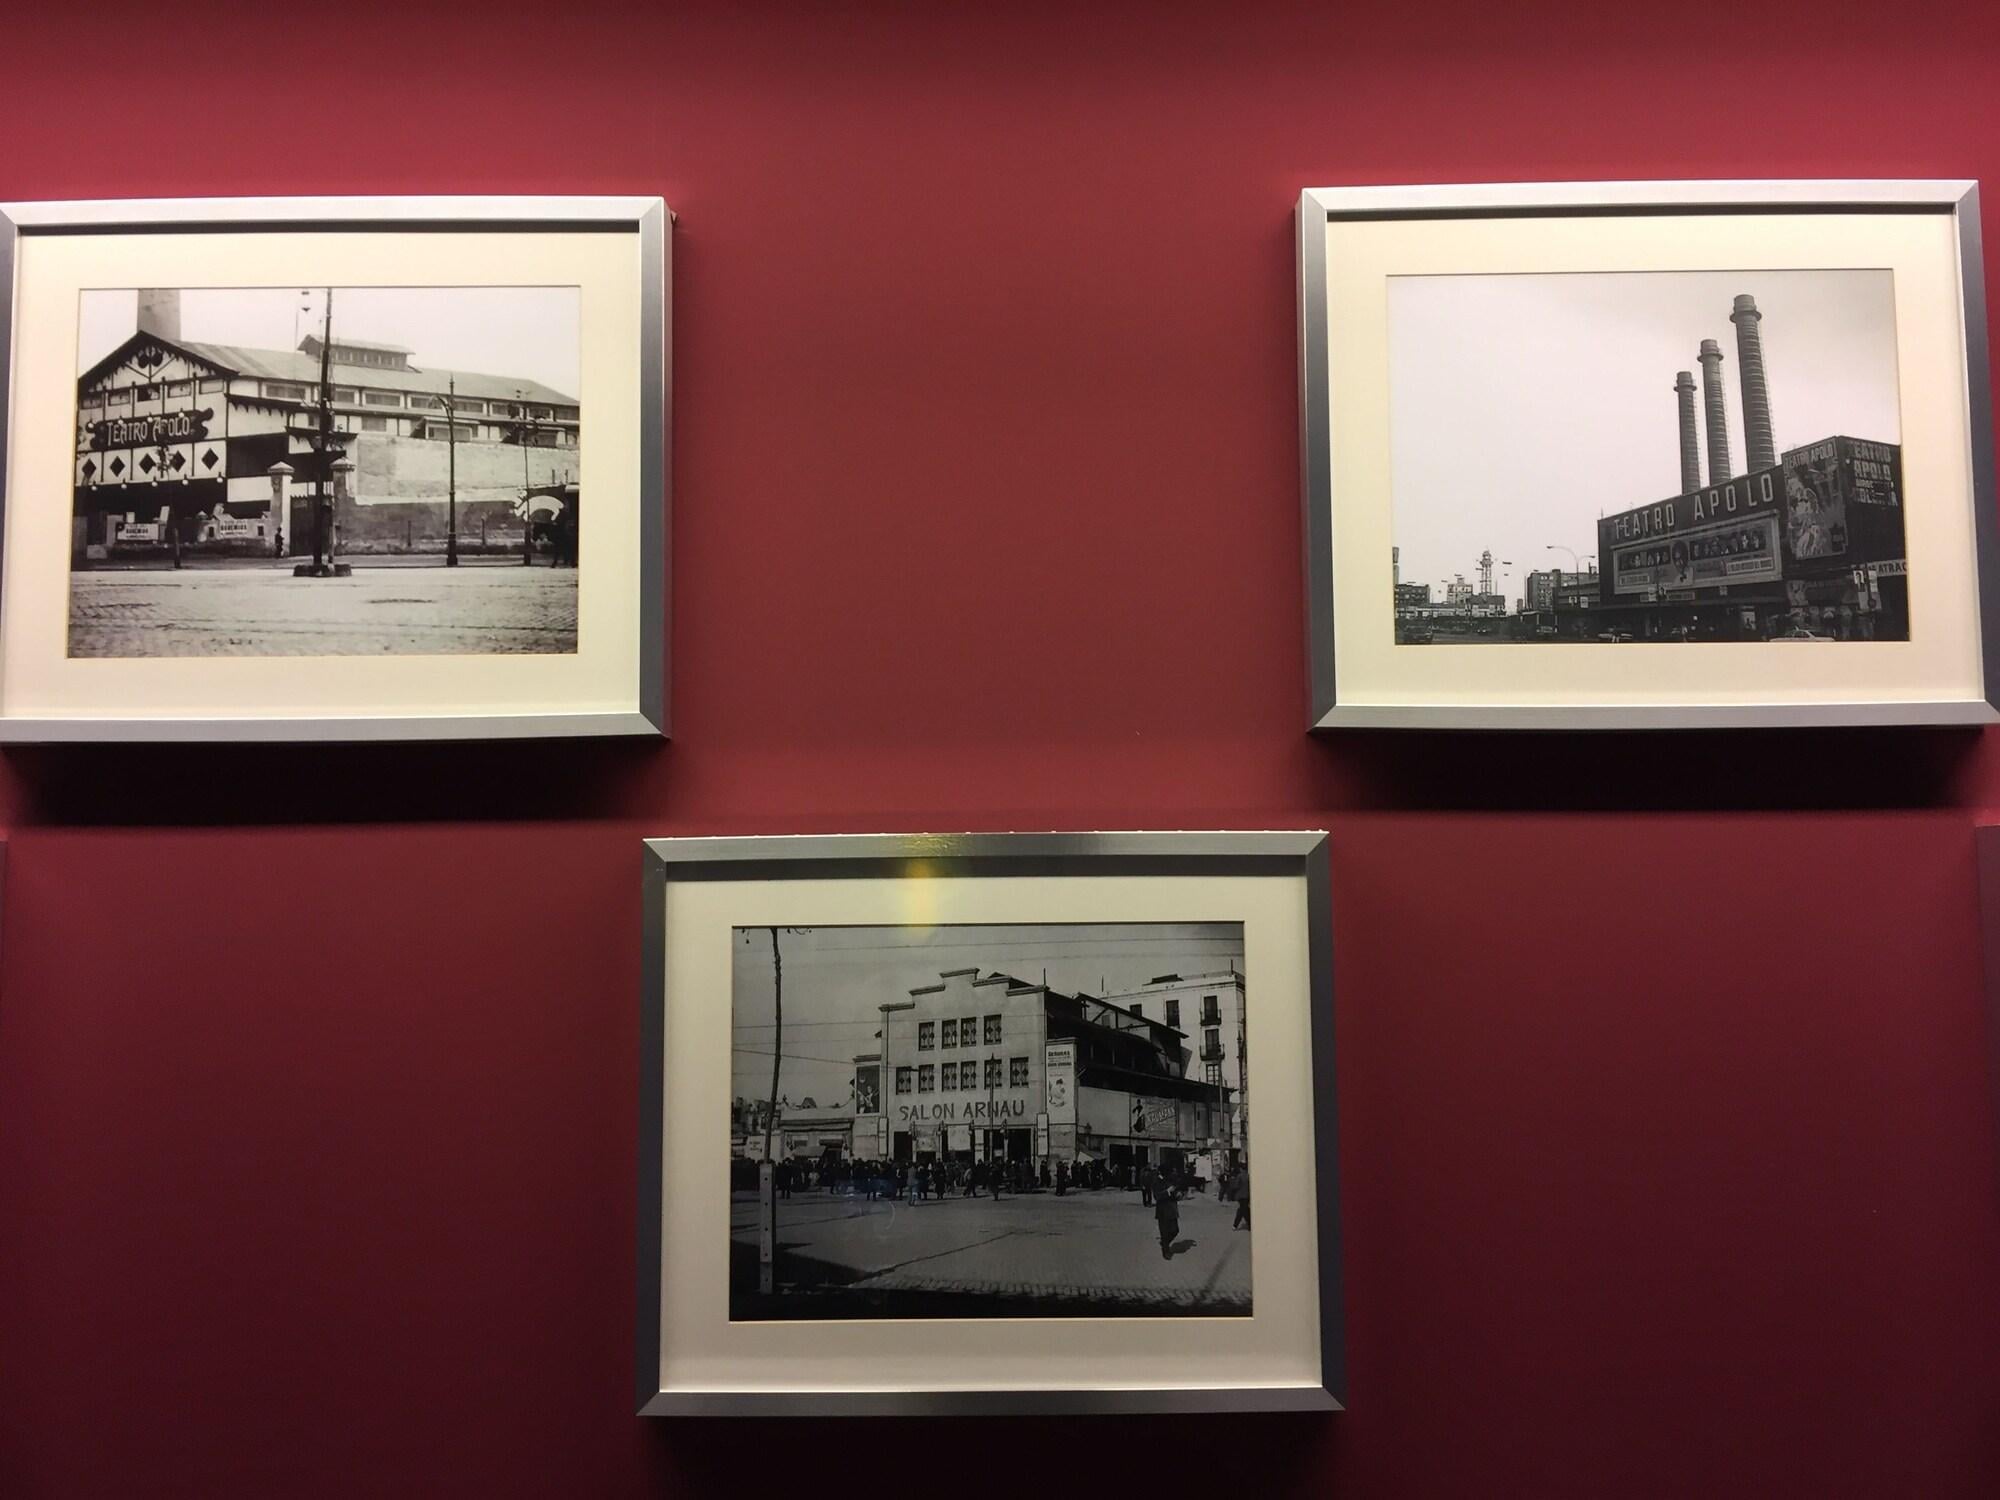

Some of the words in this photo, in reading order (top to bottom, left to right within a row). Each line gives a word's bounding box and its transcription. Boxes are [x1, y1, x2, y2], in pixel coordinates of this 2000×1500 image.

[106, 421, 148, 447] TEATRO
[1810, 444, 1834, 463] APOLO
[1614, 504, 1674, 540] TEATRO
[1694, 473, 1774, 521] APOLO
[899, 1103, 954, 1121] SALON
[963, 1099, 1024, 1118] ARNAU
